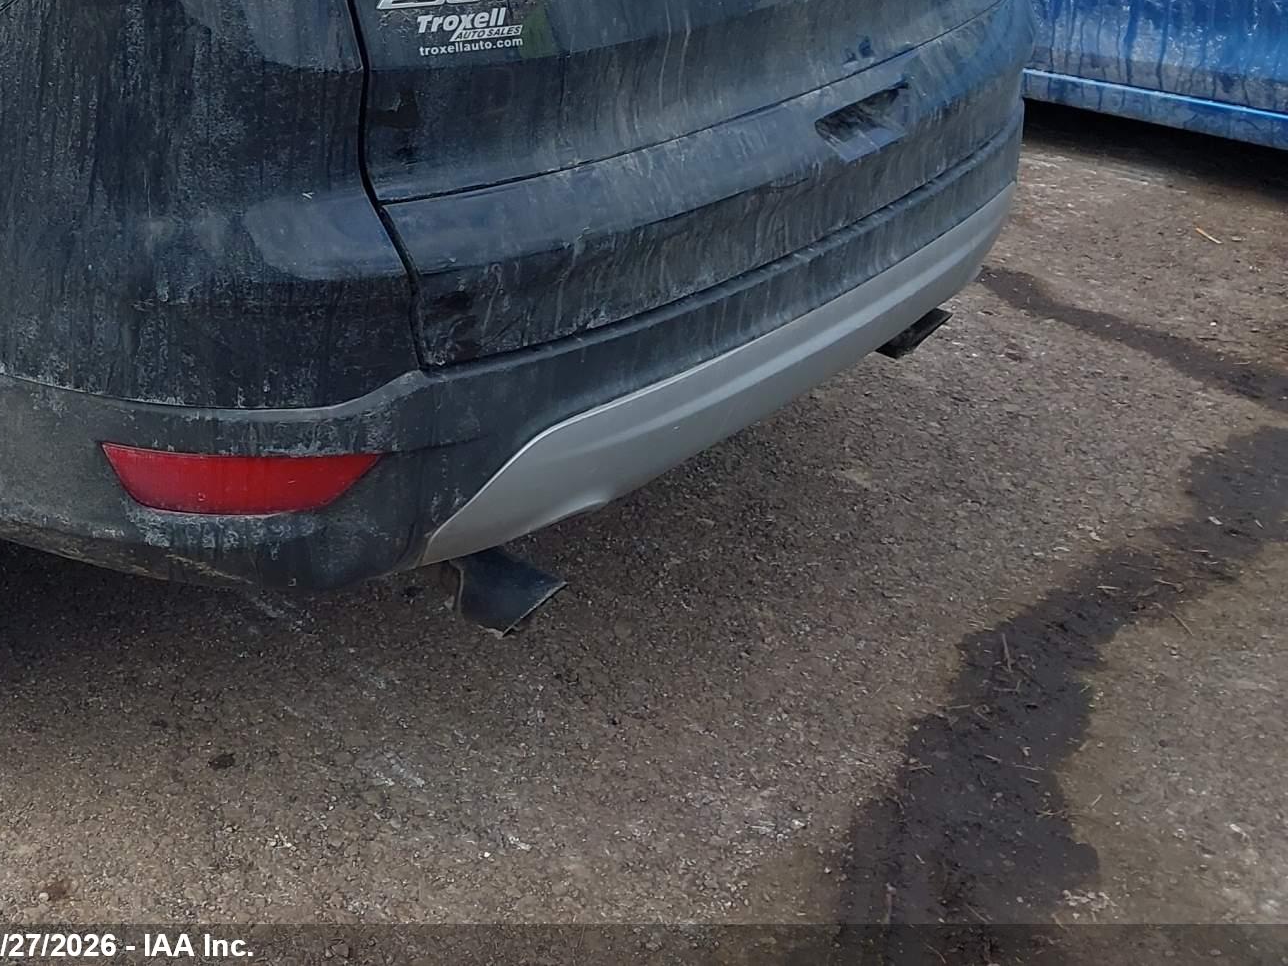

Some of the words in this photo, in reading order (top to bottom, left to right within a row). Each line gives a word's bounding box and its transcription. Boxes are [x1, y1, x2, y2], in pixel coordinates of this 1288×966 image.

[417, 7, 506, 33] Troxell
[455, 29, 485, 41] AUTO
[487, 25, 521, 38] SALES
[419, 37, 523, 56] troxellauto.com
